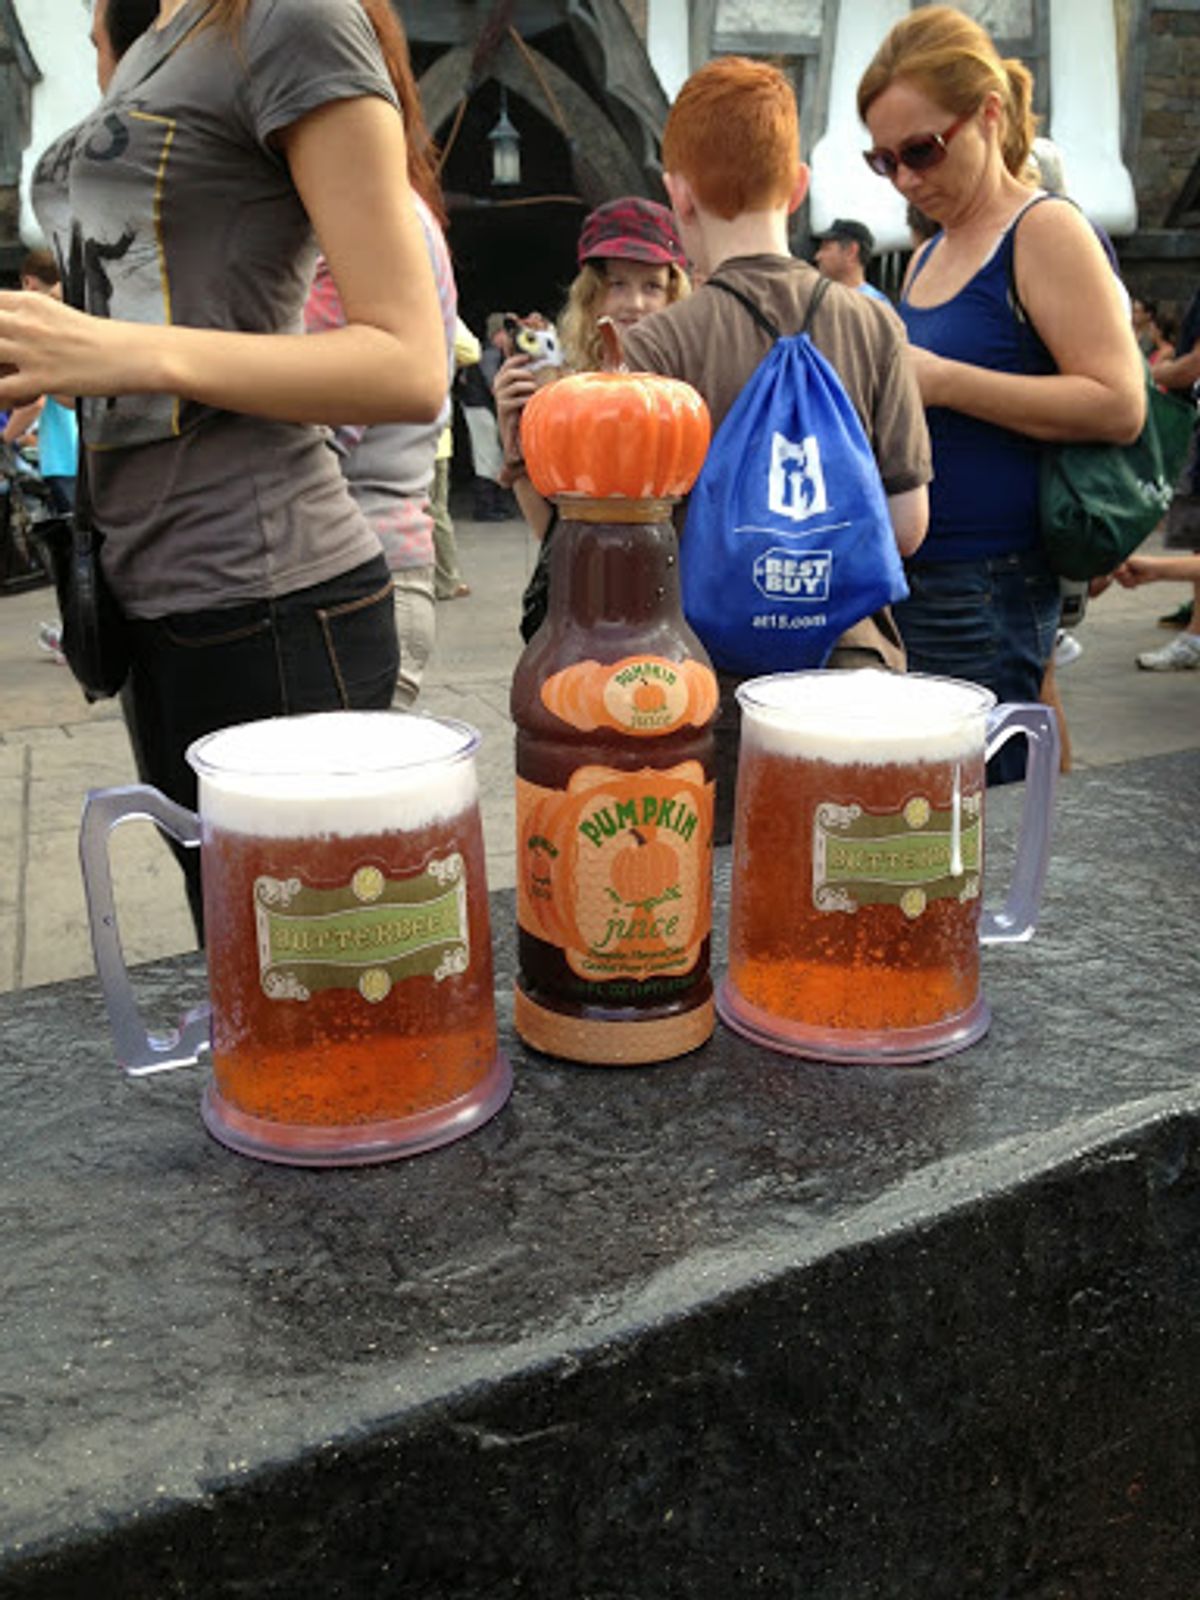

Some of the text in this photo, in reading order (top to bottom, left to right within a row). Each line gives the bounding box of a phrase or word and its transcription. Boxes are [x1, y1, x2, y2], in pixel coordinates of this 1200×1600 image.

[765, 559, 828, 576] BEST
[765, 577, 820, 594] BUY
[614, 663, 677, 686] PUMPKIN
[579, 796, 698, 848] PUMPKIN
[593, 906, 680, 948] juice
